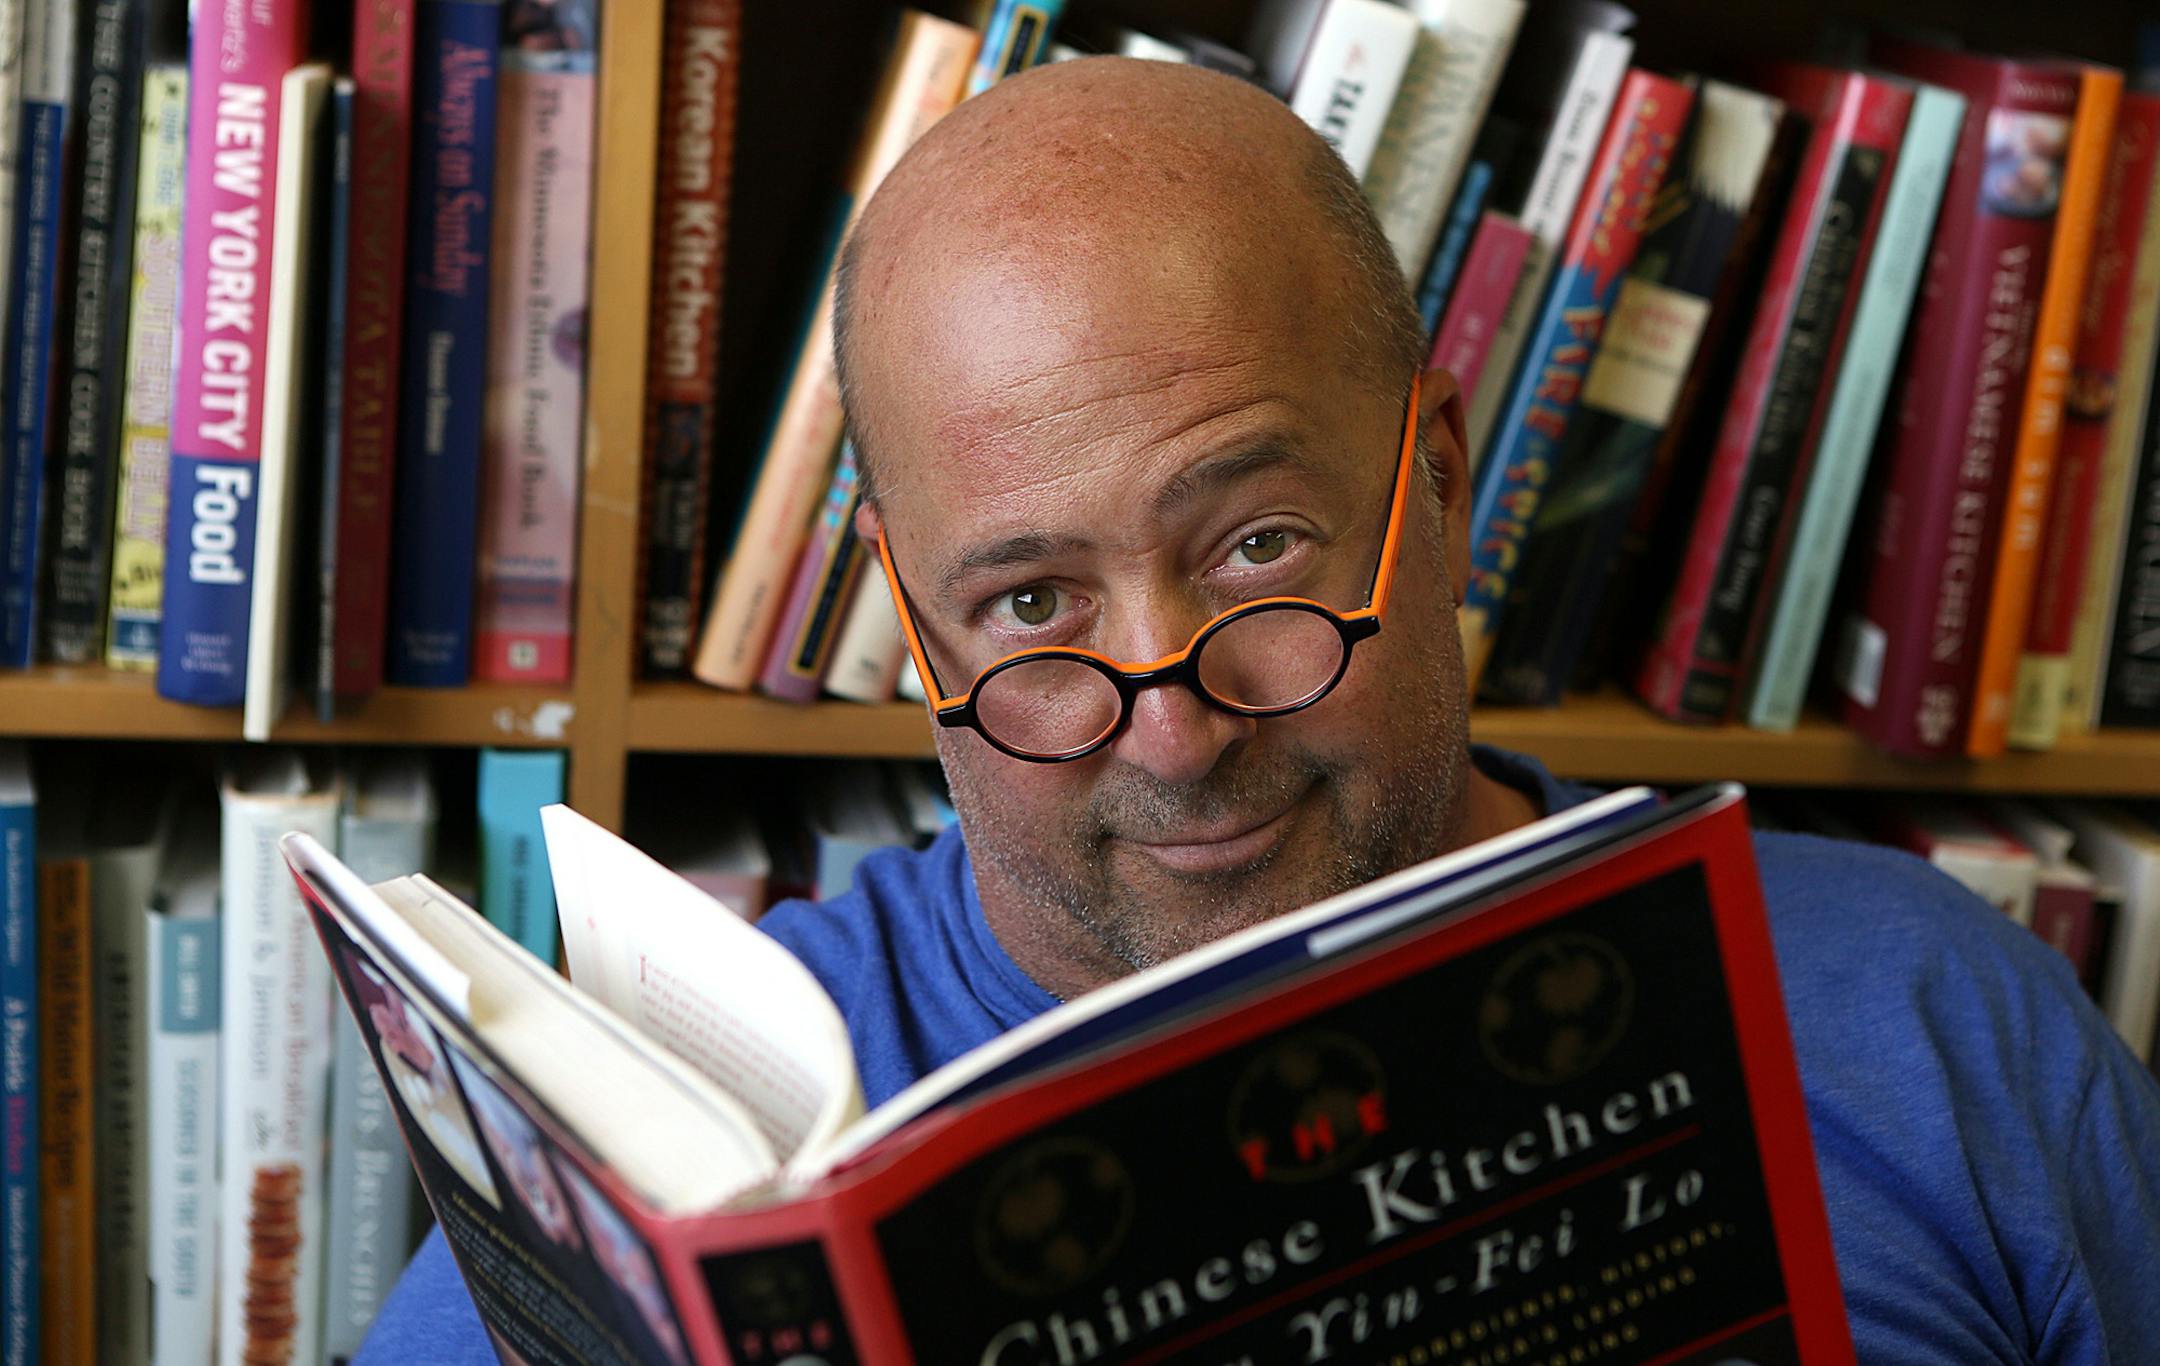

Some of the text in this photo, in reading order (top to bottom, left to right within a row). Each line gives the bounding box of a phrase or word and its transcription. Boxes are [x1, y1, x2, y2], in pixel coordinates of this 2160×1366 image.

[211, 82, 267, 198] NEW
[416, 39, 492, 297] Always on Sunday
[663, 26, 732, 376] Korean Kitchen
[202, 206, 260, 332] YORK
[529, 147, 561, 286] Minnesota
[198, 339, 252, 450] CITY
[523, 389, 551, 456] Food
[1526, 305, 1606, 440] FIRE
[1959, 244, 2032, 481] VIETNAMESE
[2032, 343, 2072, 436] dim
[190, 464, 251, 583] Food
[519, 463, 547, 529] Book
[1471, 457, 1551, 598] SPICE
[2012, 459, 2048, 549] sum
[1930, 490, 1987, 663] KITCHEN
[1239, 1091, 1388, 1181] THE
[976, 1070, 1694, 1366] Chinese Kitchen
[1288, 1168, 1705, 1362] Yin-Fei Lo
[1386, 1282, 1588, 1366] NGREDIENTS,
[1572, 1265, 1697, 1330] LEADING
